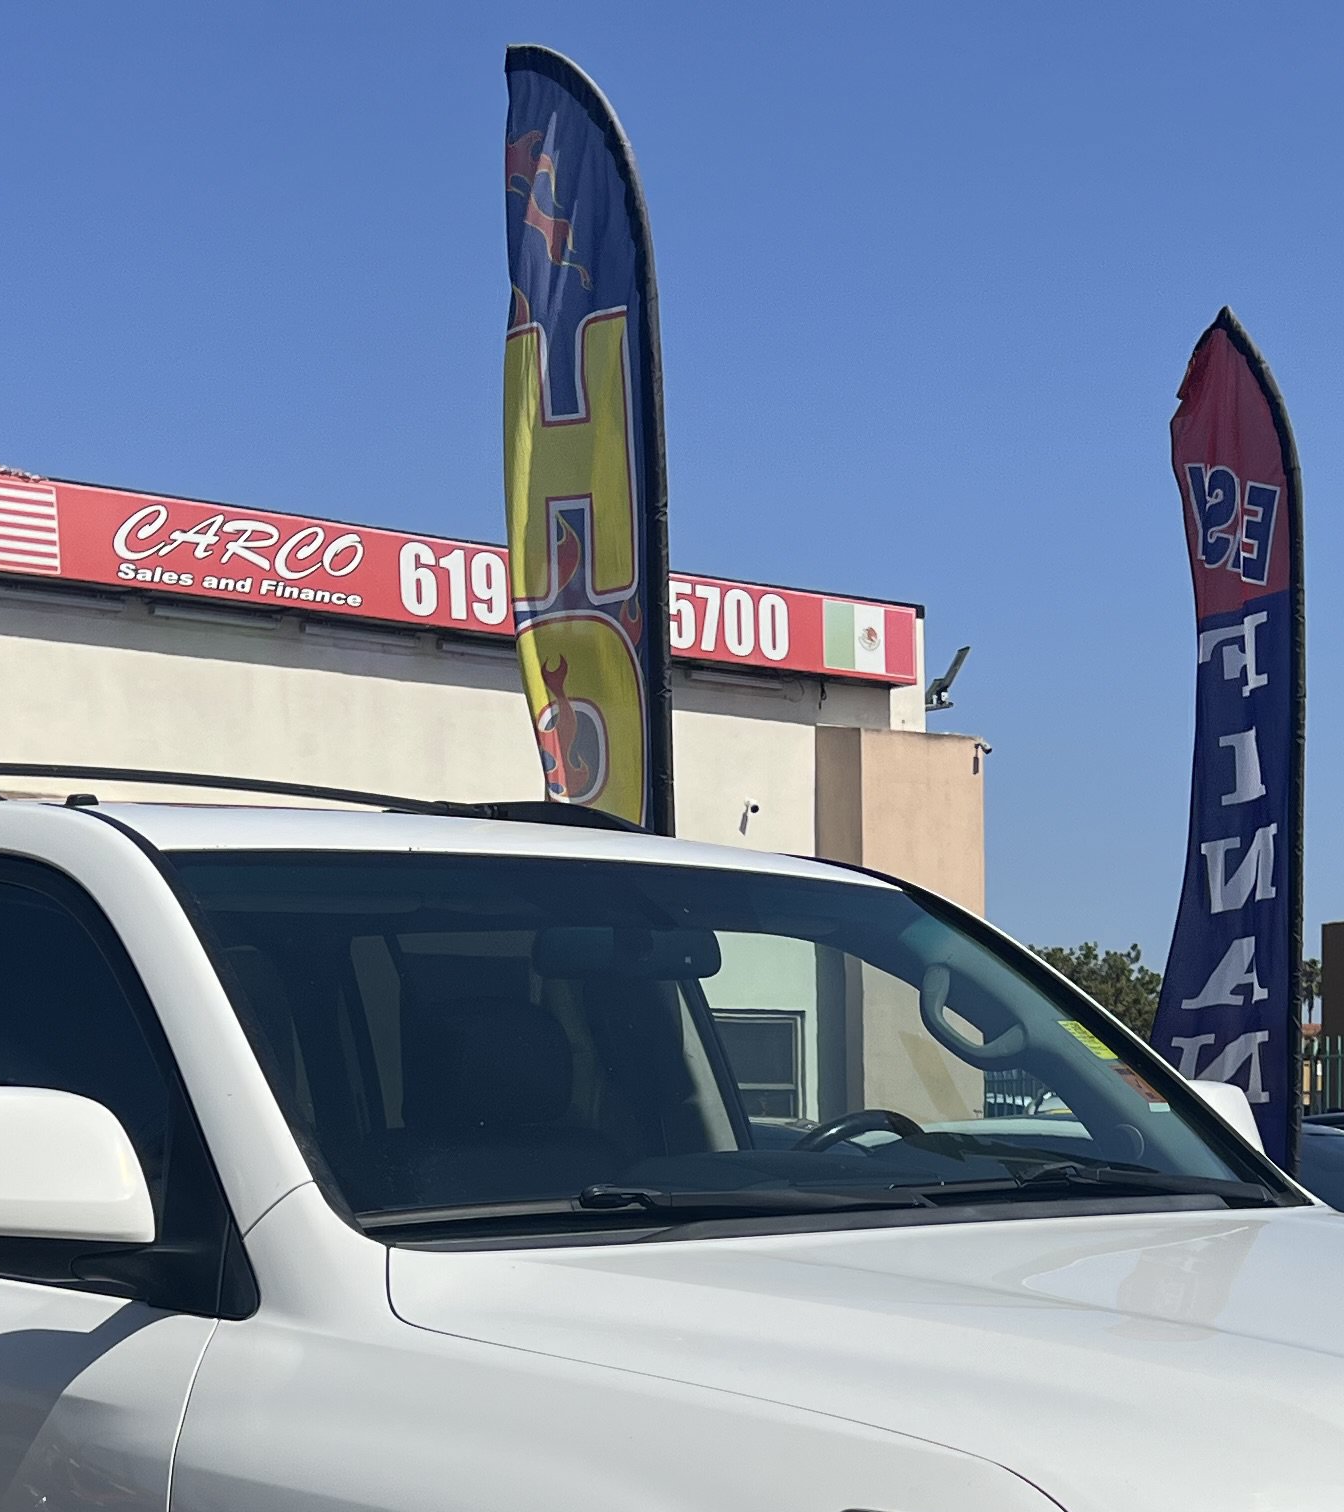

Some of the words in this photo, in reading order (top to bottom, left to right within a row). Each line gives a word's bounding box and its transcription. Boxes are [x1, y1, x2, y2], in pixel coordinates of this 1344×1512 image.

[112, 503, 364, 581] CARCO
[117, 562, 194, 587] Sales
[202, 575, 253, 594] and
[259, 578, 364, 608] Finance
[398, 540, 510, 626] 619
[669, 580, 790, 662] 5700
